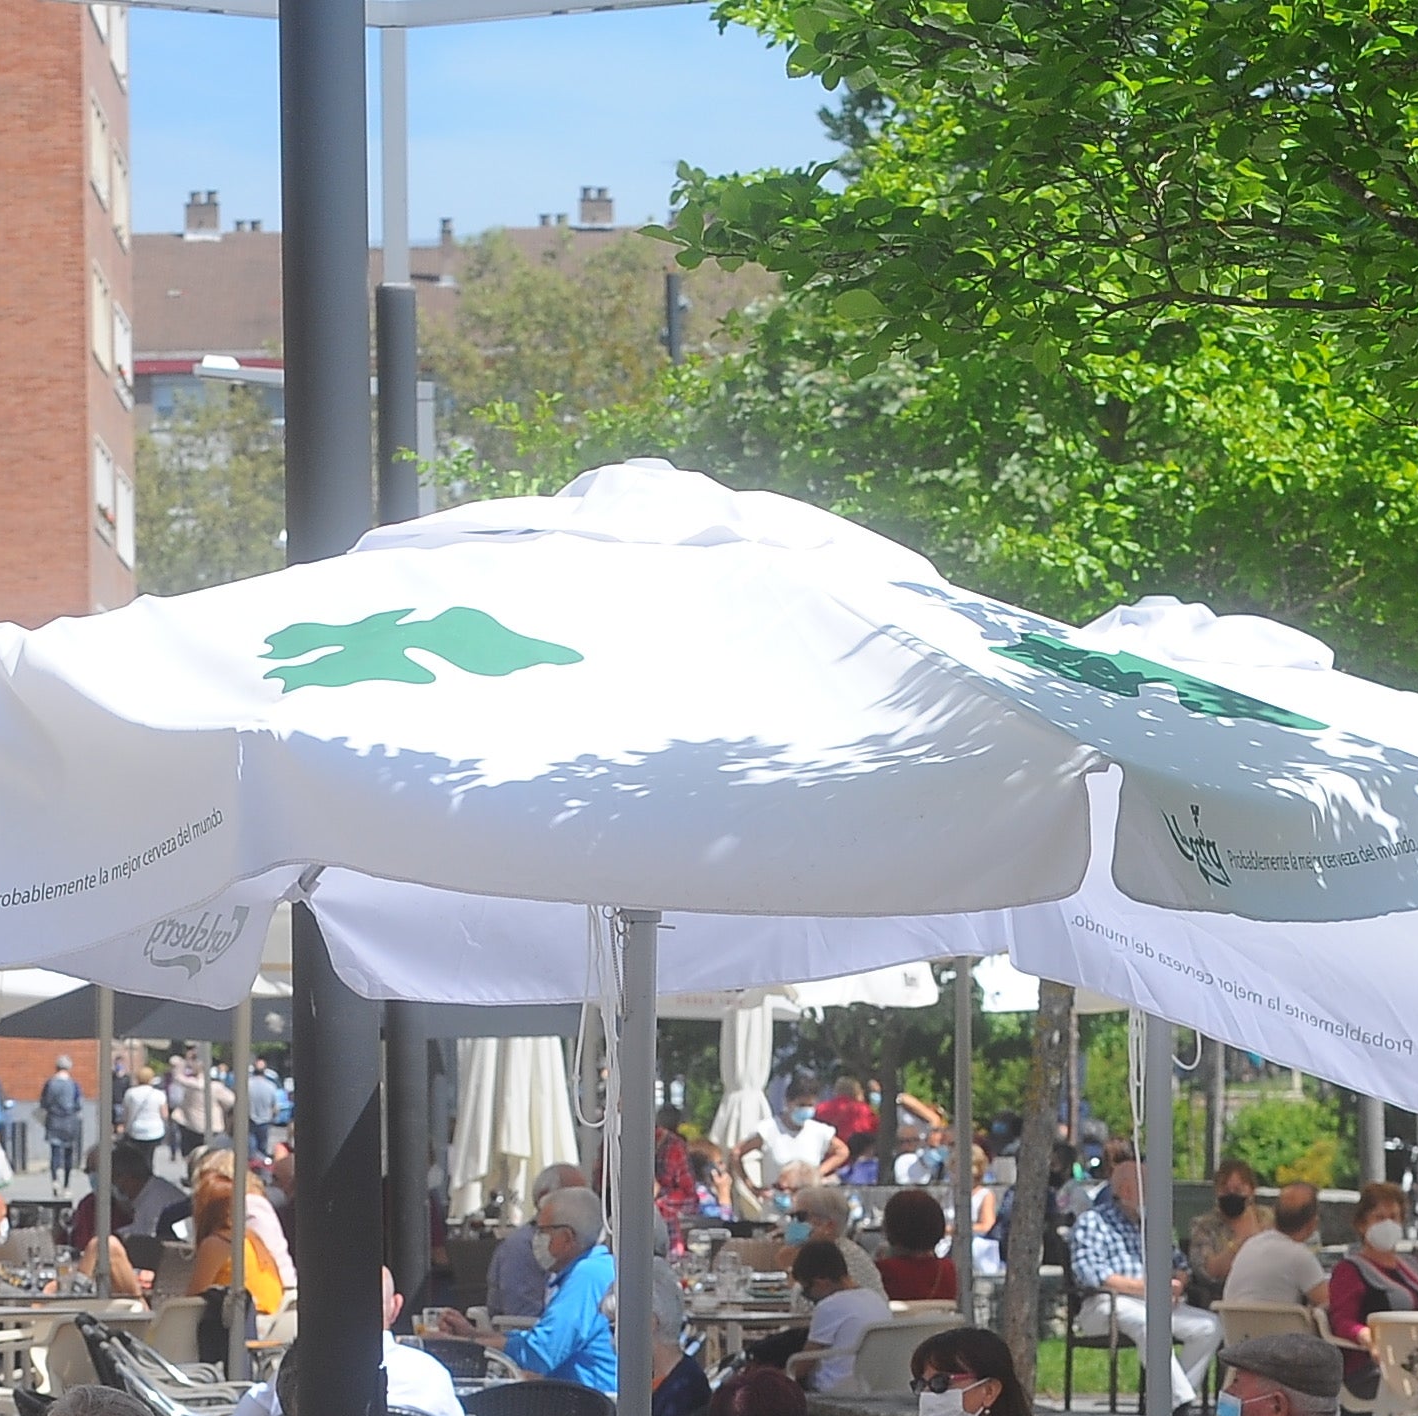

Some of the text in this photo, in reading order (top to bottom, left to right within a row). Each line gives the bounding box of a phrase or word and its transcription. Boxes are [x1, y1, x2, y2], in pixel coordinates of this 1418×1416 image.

[98, 866, 109, 885] la
[111, 855, 142, 882] mejor
[142, 836, 178, 866] cerveza
[176, 822, 192, 848] del
[1322, 851, 1360, 869] cerveza
[1358, 843, 1379, 863] del
